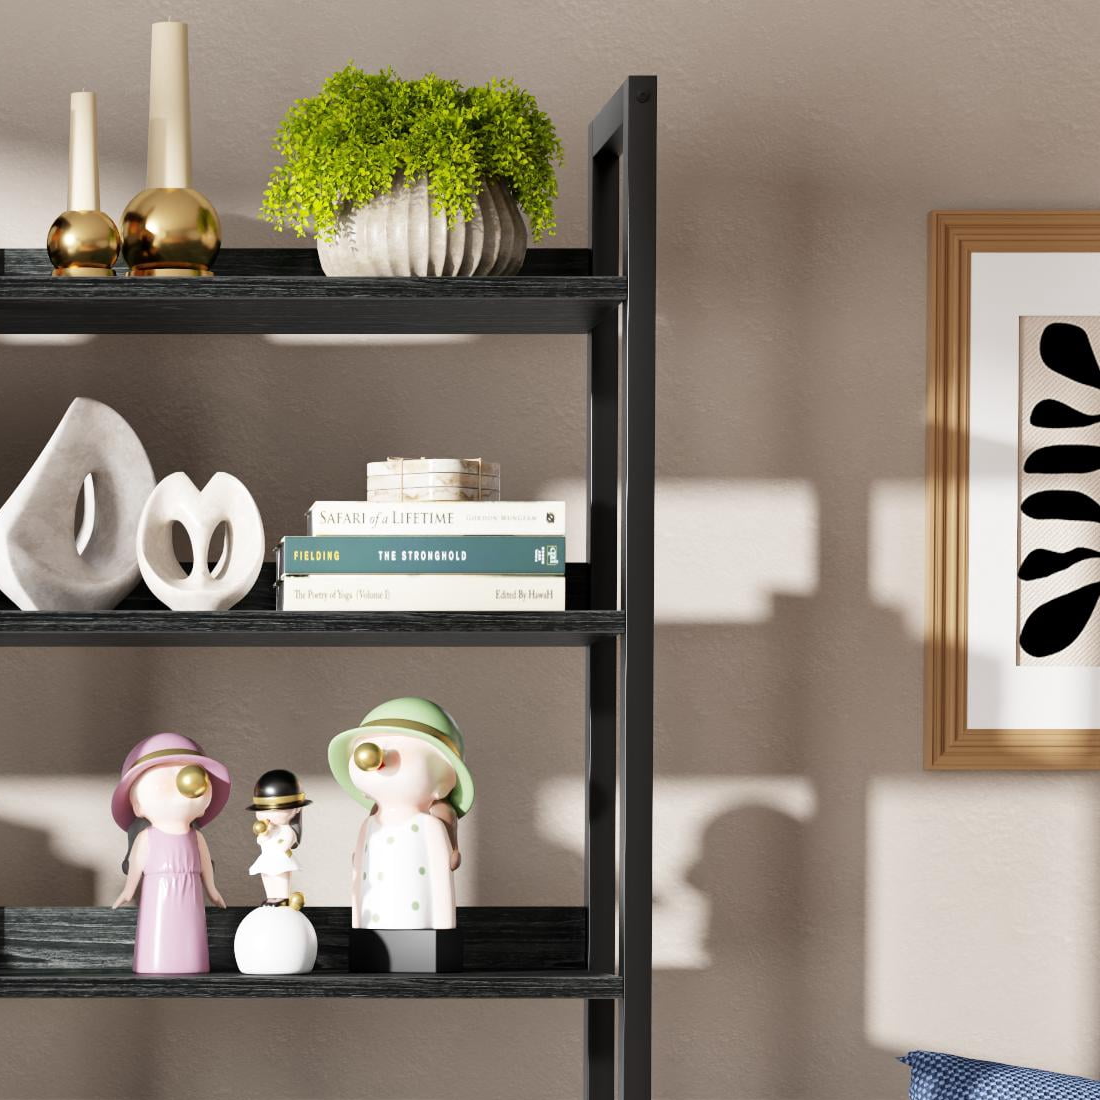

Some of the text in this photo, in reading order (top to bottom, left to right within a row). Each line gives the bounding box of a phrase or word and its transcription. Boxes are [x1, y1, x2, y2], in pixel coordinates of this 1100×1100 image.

[320, 511, 366, 525] SAFARI
[392, 511, 455, 525] LIFETIME
[293, 550, 467, 561] FIELDING THE STRONGHOLD
[294, 590, 306, 600] The
[308, 590, 328, 602] Poetry
[495, 589, 517, 600] Edited
[518, 589, 527, 602] By
